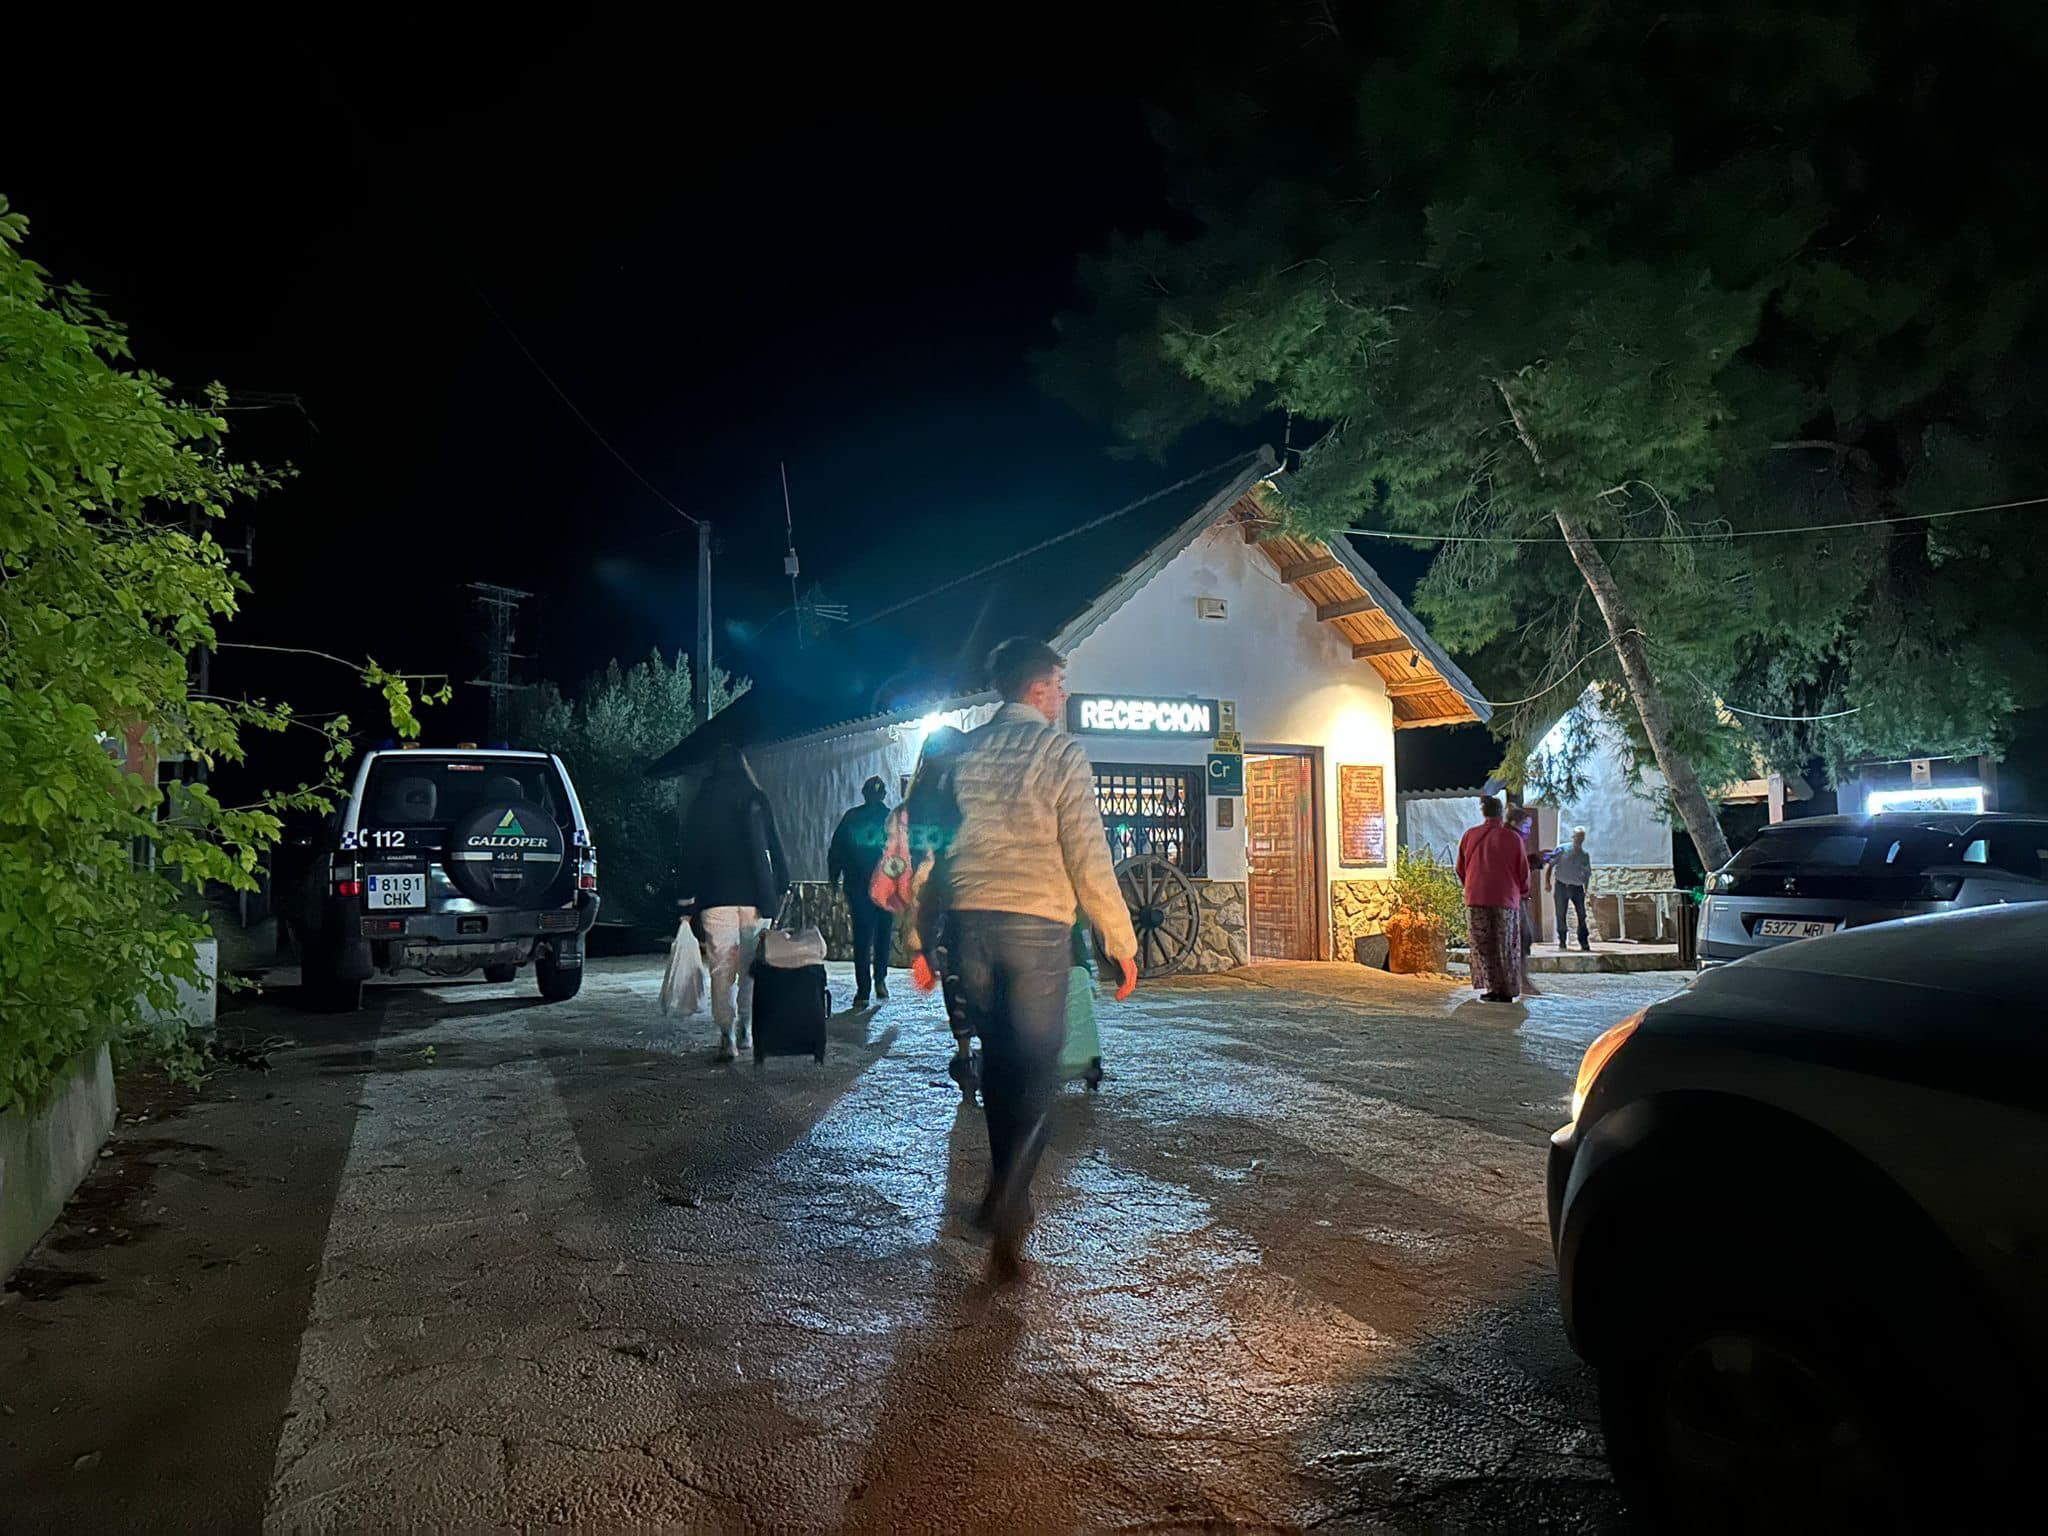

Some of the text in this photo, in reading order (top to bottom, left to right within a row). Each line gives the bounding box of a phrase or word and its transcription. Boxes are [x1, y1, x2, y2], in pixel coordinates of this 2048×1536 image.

[1081, 701, 1210, 732] RECEPCION
[1209, 759, 1230, 778] Cr
[371, 831, 405, 848] 112
[468, 836, 548, 847] GALLOPER
[382, 878, 420, 891] 8191
[383, 892, 412, 906] CHK
[1764, 921, 1797, 935] 5377
